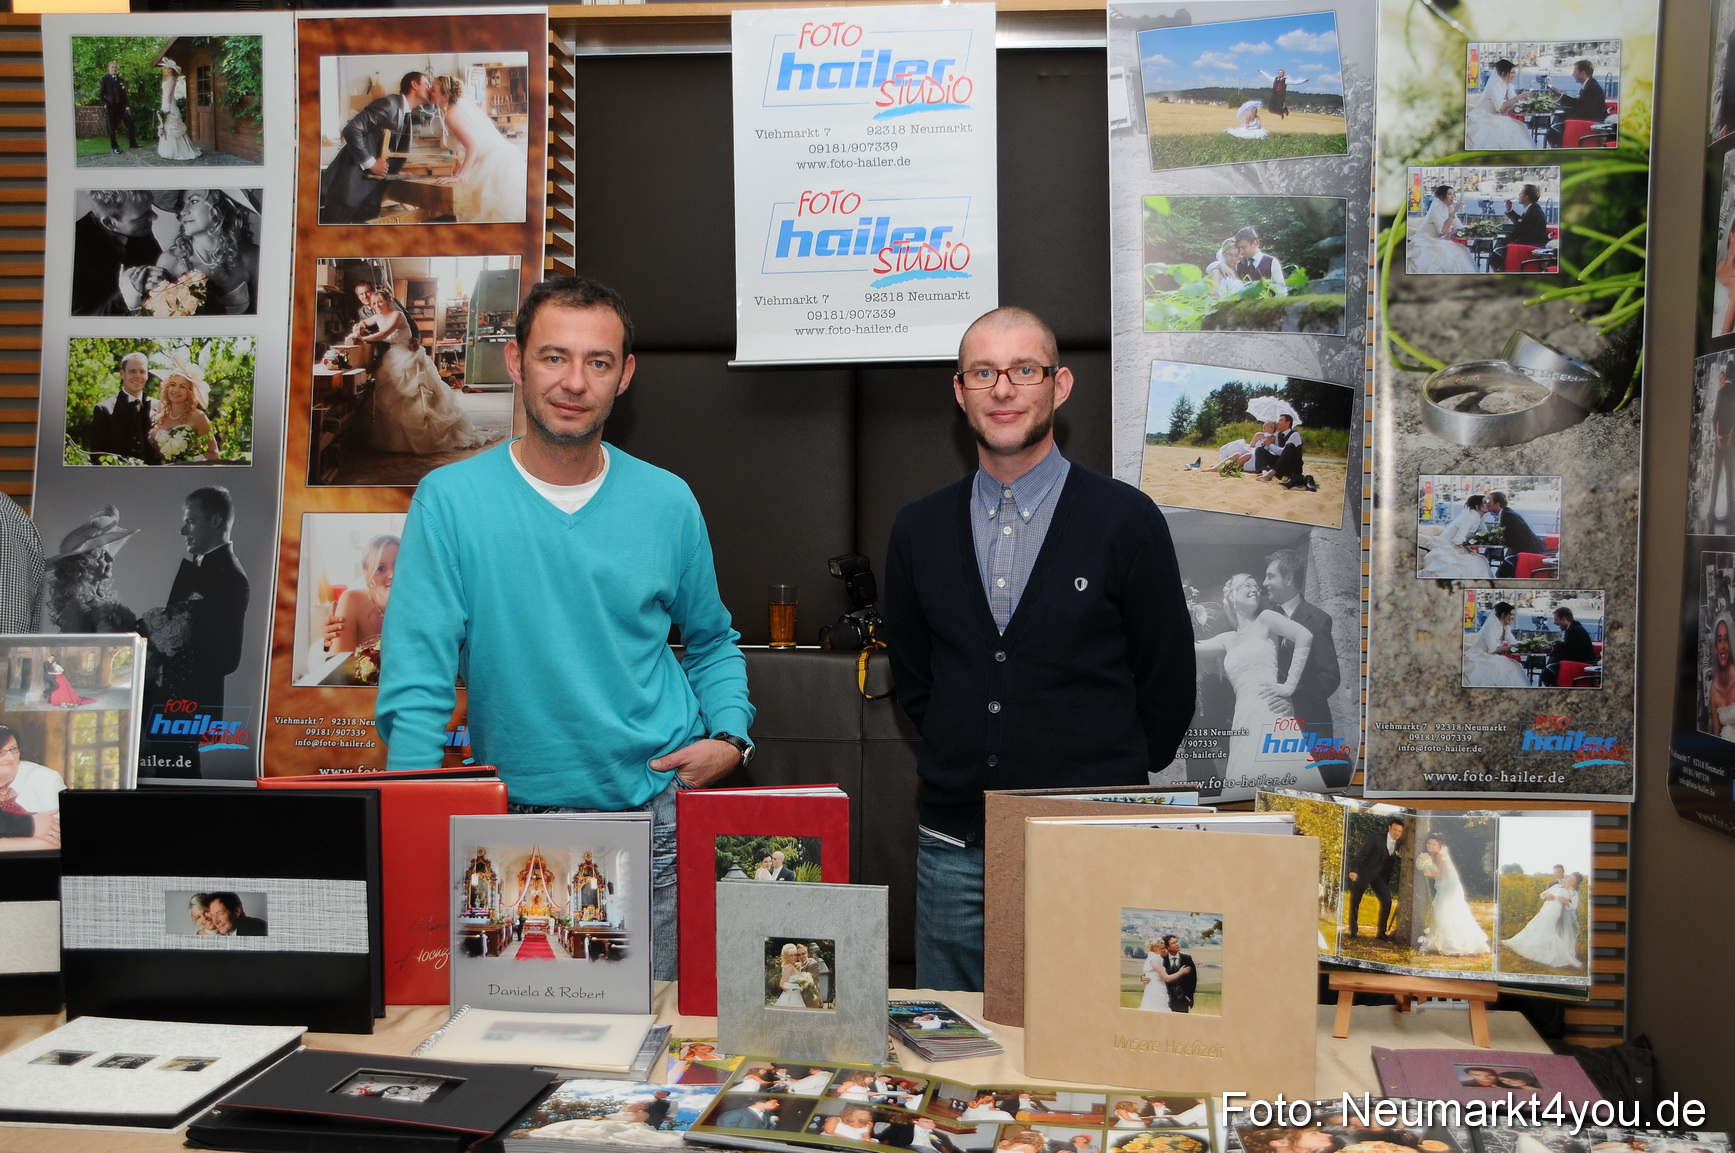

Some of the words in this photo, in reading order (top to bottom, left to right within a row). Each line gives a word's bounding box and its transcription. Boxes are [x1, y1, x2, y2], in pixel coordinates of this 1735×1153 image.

[799, 22, 862, 50] FOTO
[776, 49, 956, 91] hailer
[754, 128, 820, 140] Viehmarkt
[824, 128, 832, 138] 7
[866, 125, 906, 136] 92318
[910, 123, 973, 134] Neumarkt
[808, 142, 898, 154] 09181/907339
[796, 156, 911, 170] www.foto-hailer.de
[798, 190, 862, 218] FOTO
[775, 216, 954, 258] hailer
[754, 294, 818, 306] Viehmarkt
[822, 294, 830, 304] 7
[864, 292, 904, 302] 92318
[908, 290, 971, 302] Neumarkt
[807, 308, 896, 321] 09181/907339
[794, 324, 909, 337] www.foto-hailer.de
[163, 698, 198, 714] FOTO
[150, 713, 242, 735] hailer
[274, 716, 316, 725] Viehmarkt
[331, 718, 356, 726] 92318
[359, 718, 376, 726] Neu
[1273, 718, 1305, 732] FOTO
[1375, 722, 1420, 731] Viehmarkt
[1422, 722, 1428, 730] 7
[1435, 724, 1462, 732] 92318
[1464, 724, 1507, 732] Neumarkt
[1533, 714, 1571, 730] FOTO
[306, 728, 366, 737] 09181/907339
[1210, 728, 1249, 737] Neumarkt
[1408, 733, 1472, 742] 09181/907339
[295, 739, 376, 748] info@foto-hailer.de
[1262, 732, 1345, 754] hailer
[1521, 730, 1618, 751] hailer
[1175, 750, 1228, 760] oto-hailer.de
[1398, 744, 1482, 753] info@foto-hailer.de
[140, 755, 192, 768] ailer.de
[1422, 770, 1566, 784] www.foto-hailer.de
[488, 984, 540, 998] Daniela
[544, 986, 556, 998] &
[560, 986, 606, 999] Robert
